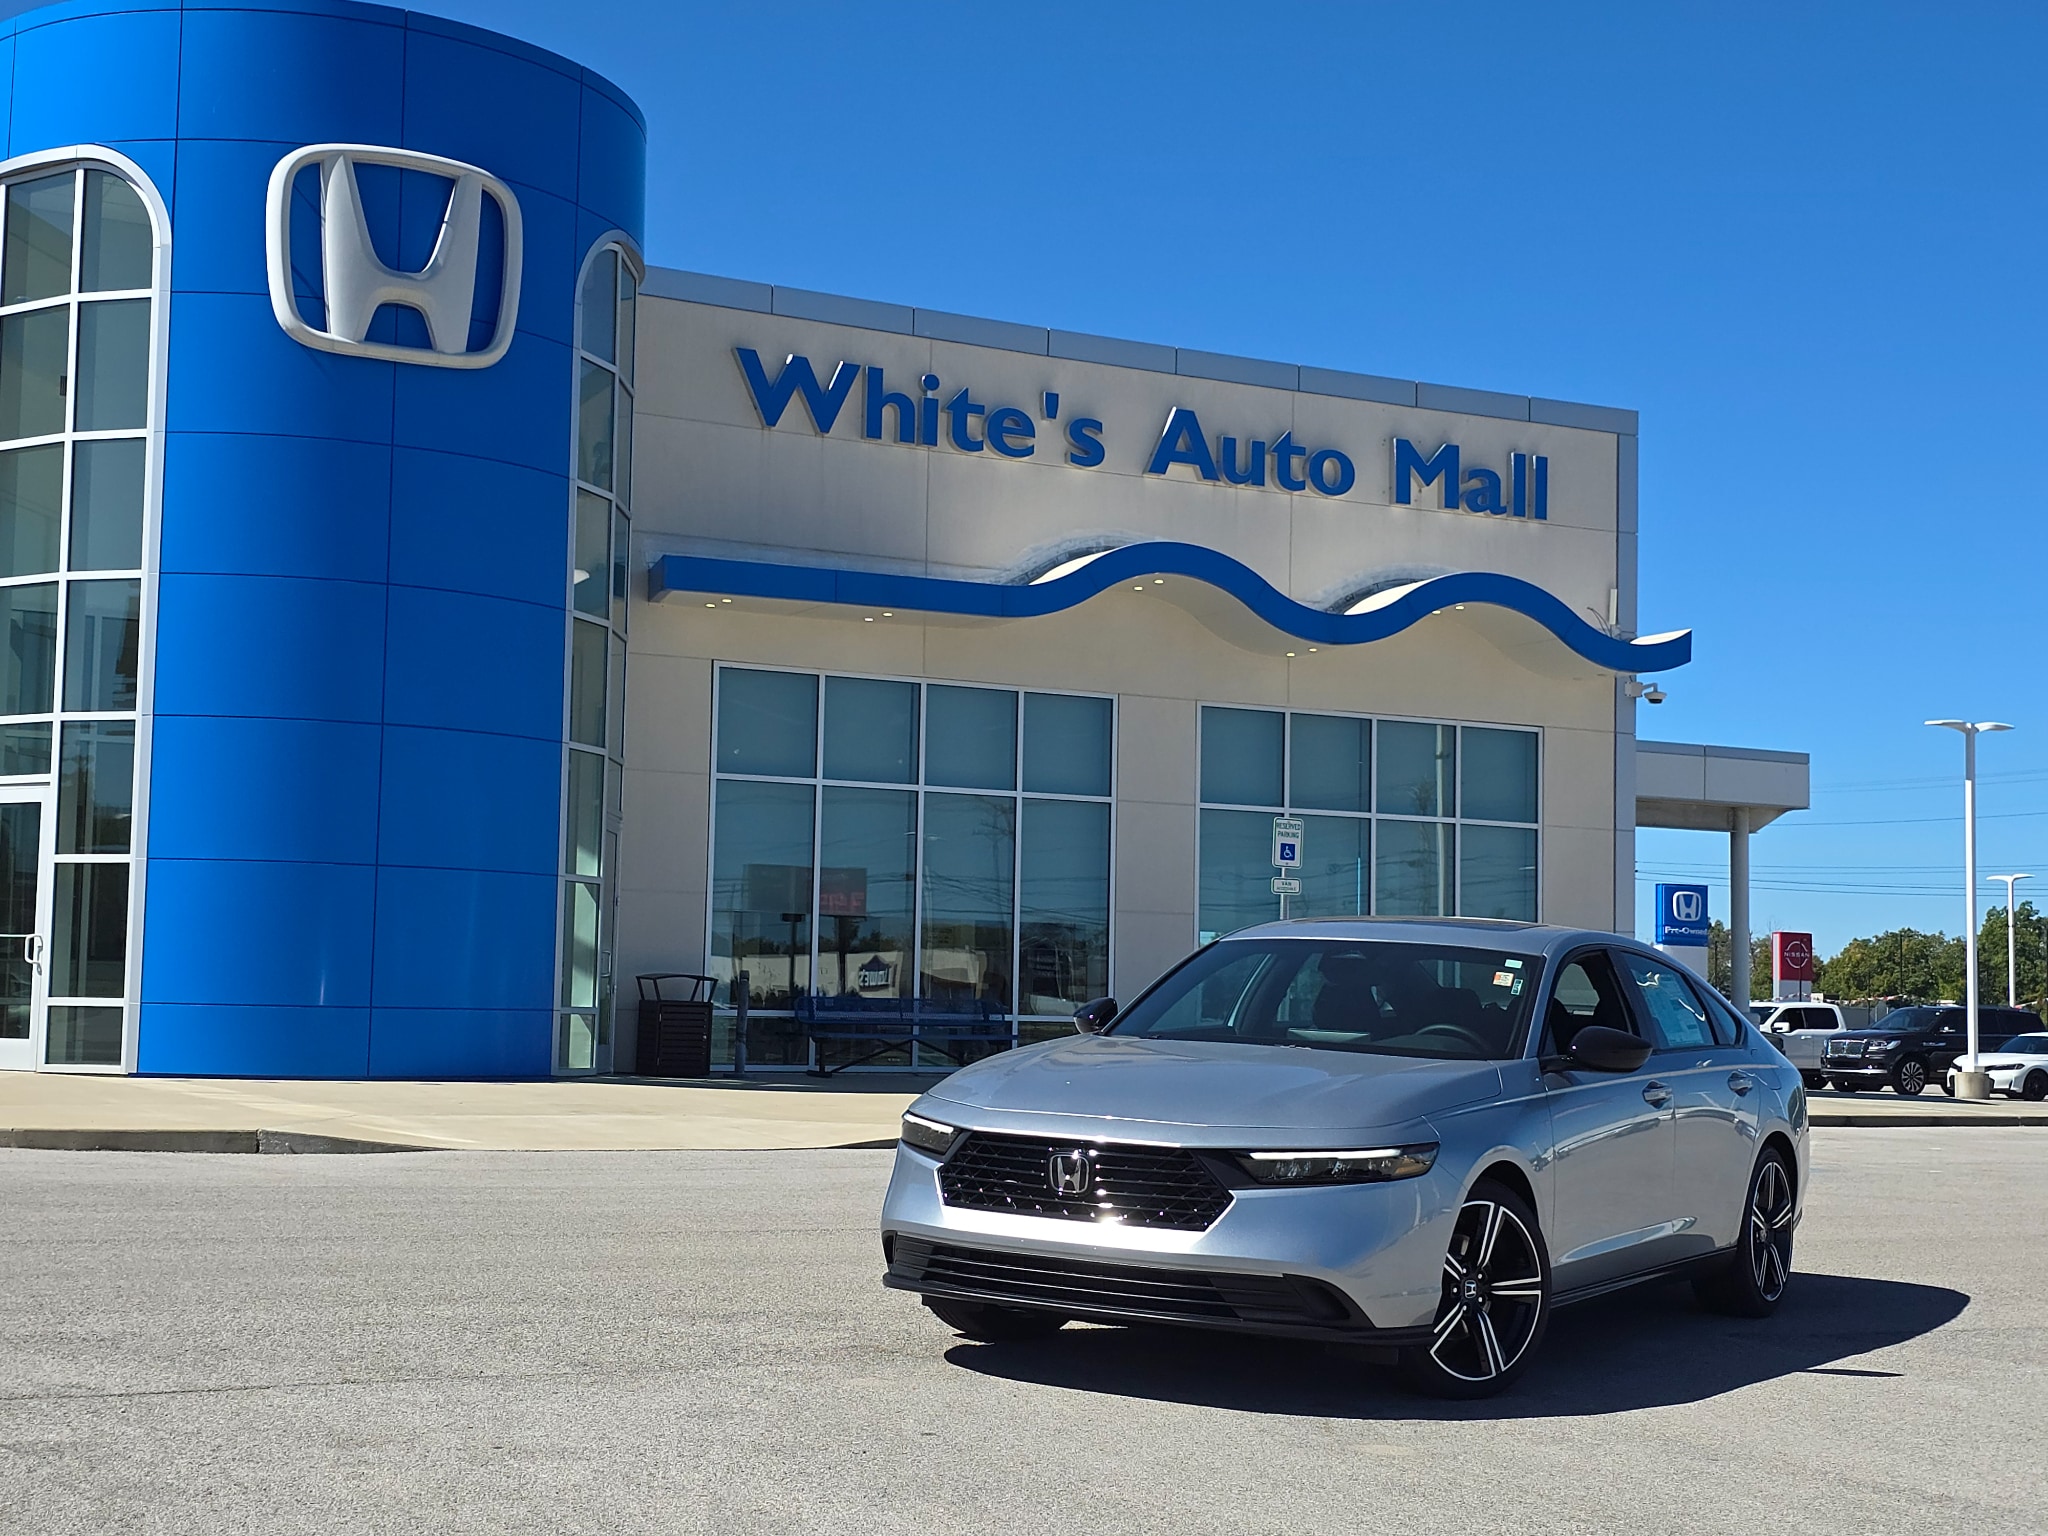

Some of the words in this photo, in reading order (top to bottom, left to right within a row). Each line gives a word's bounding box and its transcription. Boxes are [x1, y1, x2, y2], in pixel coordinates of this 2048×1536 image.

[732, 346, 1105, 469] White's
[1146, 406, 1356, 498] Auto
[1393, 437, 1549, 522] Mall
[1276, 823, 1301, 831] RESERVED
[1277, 831, 1300, 839] PARKING
[1664, 925, 1708, 936] Pre-Owned
